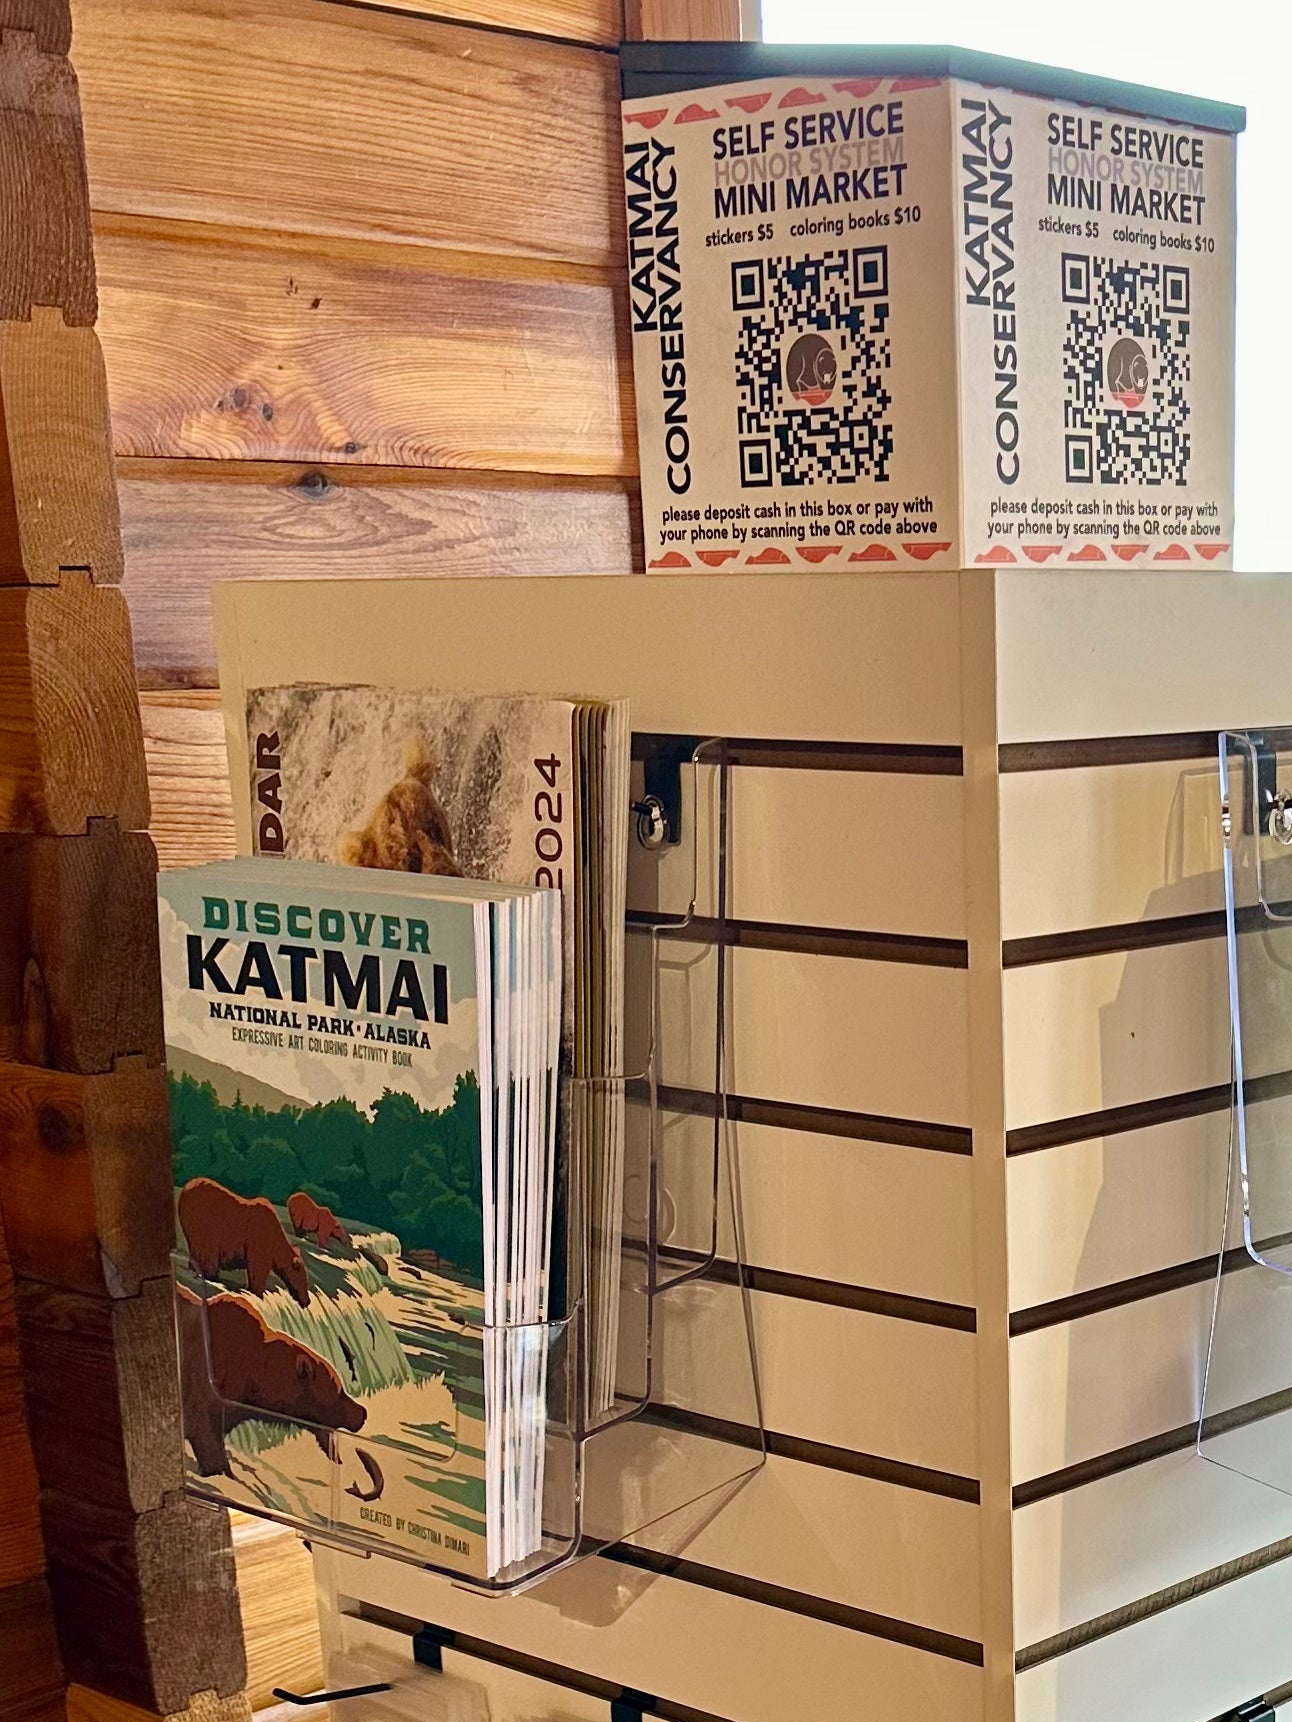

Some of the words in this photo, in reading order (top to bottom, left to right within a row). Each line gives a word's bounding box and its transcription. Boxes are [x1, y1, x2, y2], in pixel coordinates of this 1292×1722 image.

[713, 121, 774, 159] SELF
[785, 102, 904, 149] SERVICE
[1048, 113, 1102, 151] SELF
[1110, 124, 1204, 168] SERVICE
[715, 150, 800, 187] HONOR
[810, 137, 904, 174] SYSTEM
[1048, 147, 1125, 183] HONOR
[1131, 161, 1203, 195] SYSTEM
[715, 180, 776, 218] MINI
[786, 164, 907, 209] MARKET
[961, 98, 991, 306] KATMAI
[1048, 173, 1101, 212] MINI
[1111, 183, 1205, 225] MARKET
[624, 142, 657, 332] KATMAI
[705, 226, 754, 247] stickers
[757, 223, 774, 242] $5
[790, 216, 844, 237] coloring
[849, 210, 890, 230] books
[894, 205, 921, 225] $10
[1038, 216, 1082, 237] stickers
[1085, 221, 1099, 238] $5
[1113, 226, 1156, 250] coloring
[1160, 230, 1192, 250] books
[1195, 236, 1215, 253] $10
[651, 136, 692, 495] CONSERVANCY
[988, 99, 1019, 485] CONSERVANCY
[660, 527, 687, 545] your
[691, 524, 728, 544] phone
[732, 523, 747, 543] by
[751, 522, 805, 541] scanning
[809, 521, 830, 536] the
[835, 520, 855, 536] QR
[860, 519, 891, 535] code
[896, 518, 937, 534] above
[662, 506, 700, 525] please
[704, 504, 750, 524] deposit
[754, 502, 781, 519] cash
[785, 501, 796, 518] in
[800, 500, 824, 517] this
[827, 499, 852, 516] box
[856, 502, 870, 515] or
[875, 500, 899, 519] pay
[903, 496, 933, 513] with
[987, 520, 1014, 539] your
[1018, 518, 1052, 538] phone
[1056, 519, 1069, 538] by
[1073, 520, 1120, 539] scanning
[1123, 520, 1140, 535] the
[1143, 520, 1159, 536] QR
[1163, 520, 1187, 536] code
[1190, 521, 1221, 536] above
[990, 497, 1027, 518] please
[1031, 498, 1073, 518] deposit
[1076, 499, 1100, 515] cash
[1103, 499, 1112, 515] in
[1116, 499, 1135, 516] this
[1138, 500, 1157, 516] box
[1161, 504, 1172, 516] or
[1175, 504, 1193, 520] pay
[1196, 501, 1218, 517] with
[256, 730, 285, 858] DAR
[534, 753, 563, 893] 2024
[201, 896, 431, 954] DISCOVER
[185, 933, 449, 1025] KATMAI
[209, 1001, 302, 1030] NATIONAL
[307, 1014, 354, 1038] PARK
[363, 1022, 432, 1050] ALASKA
[232, 1028, 284, 1049] EXPRESSIVE
[288, 1035, 304, 1050] ART
[308, 1037, 348, 1057] COLORING
[352, 1044, 388, 1063] ACTIVITY
[392, 1050, 413, 1068] BOOK
[360, 1506, 392, 1528] CREATED
[396, 1517, 405, 1531] BY
[408, 1521, 442, 1546] CHRISTINA
